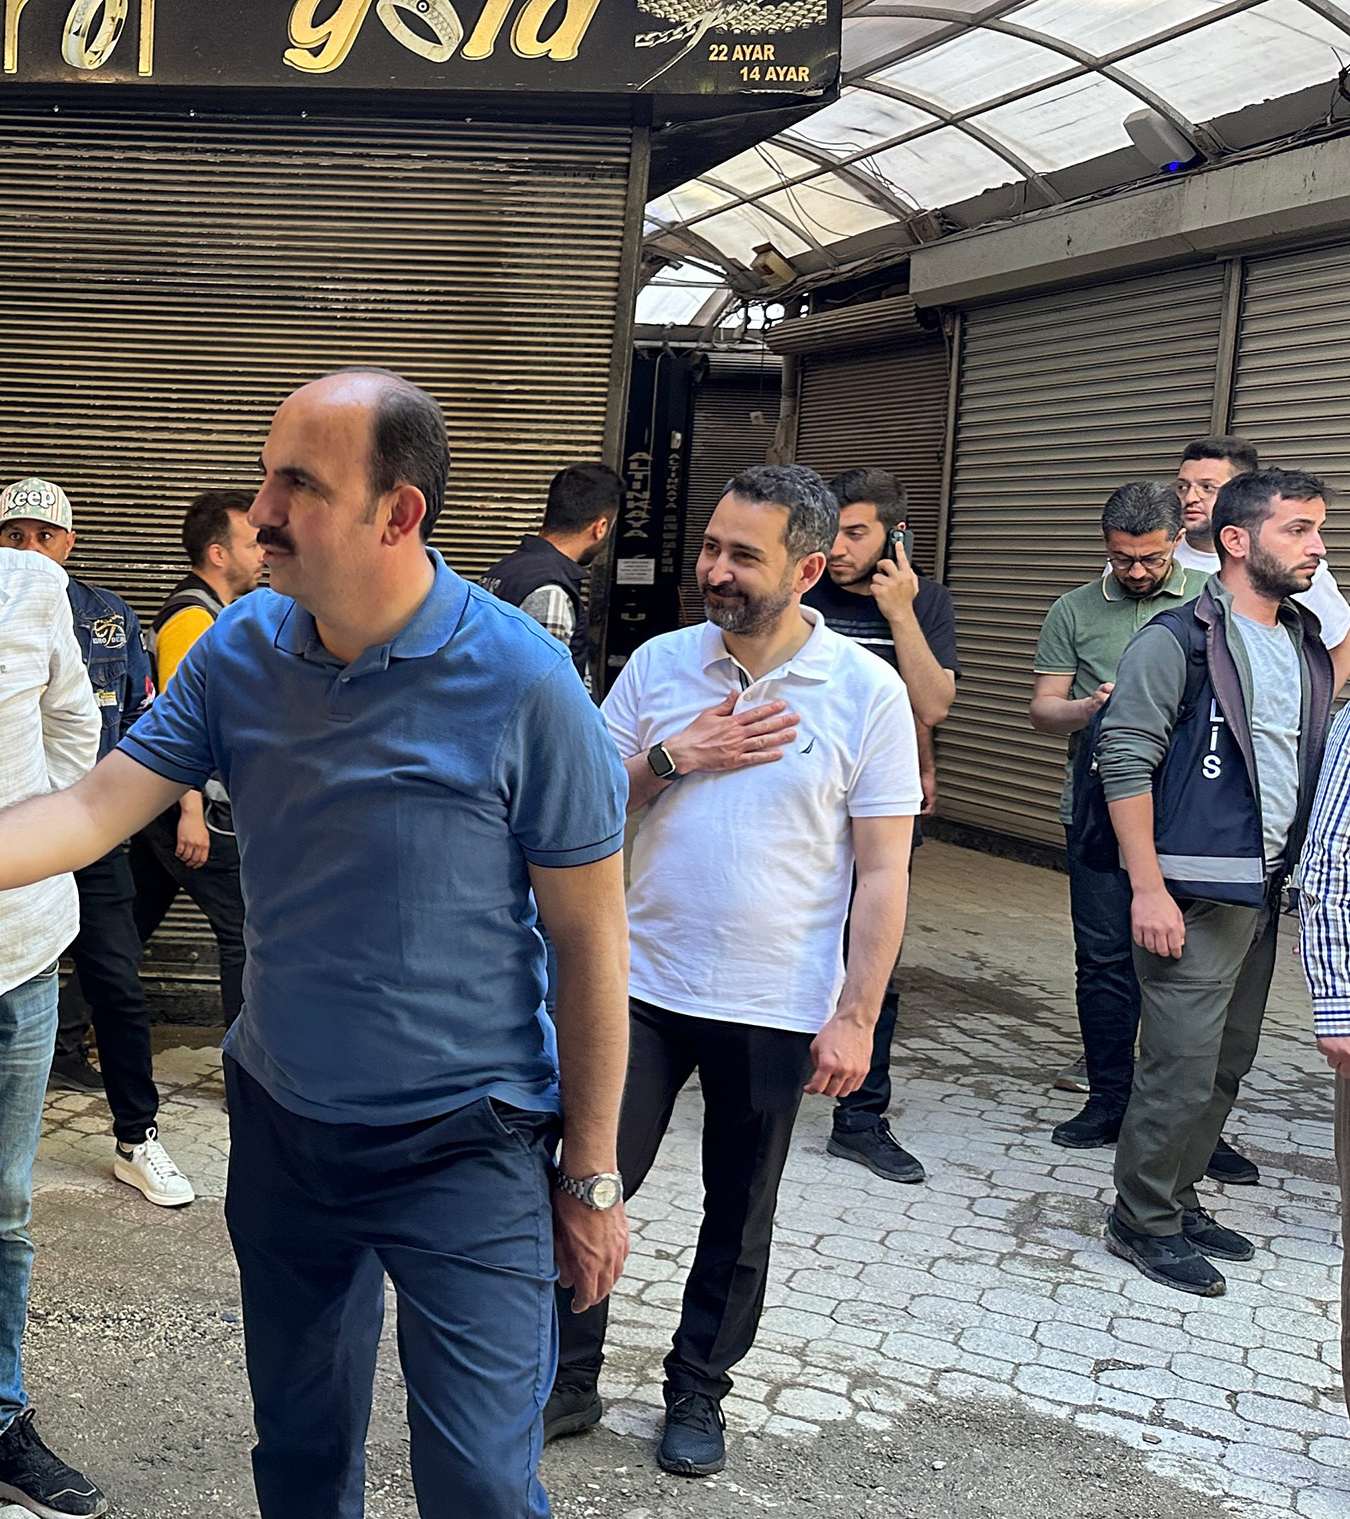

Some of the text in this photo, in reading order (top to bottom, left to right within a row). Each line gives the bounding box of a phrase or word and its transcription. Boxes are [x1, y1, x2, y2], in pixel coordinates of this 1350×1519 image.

[708, 44, 776, 61] 22 AYAR
[739, 66, 810, 82] 14 AYAR
